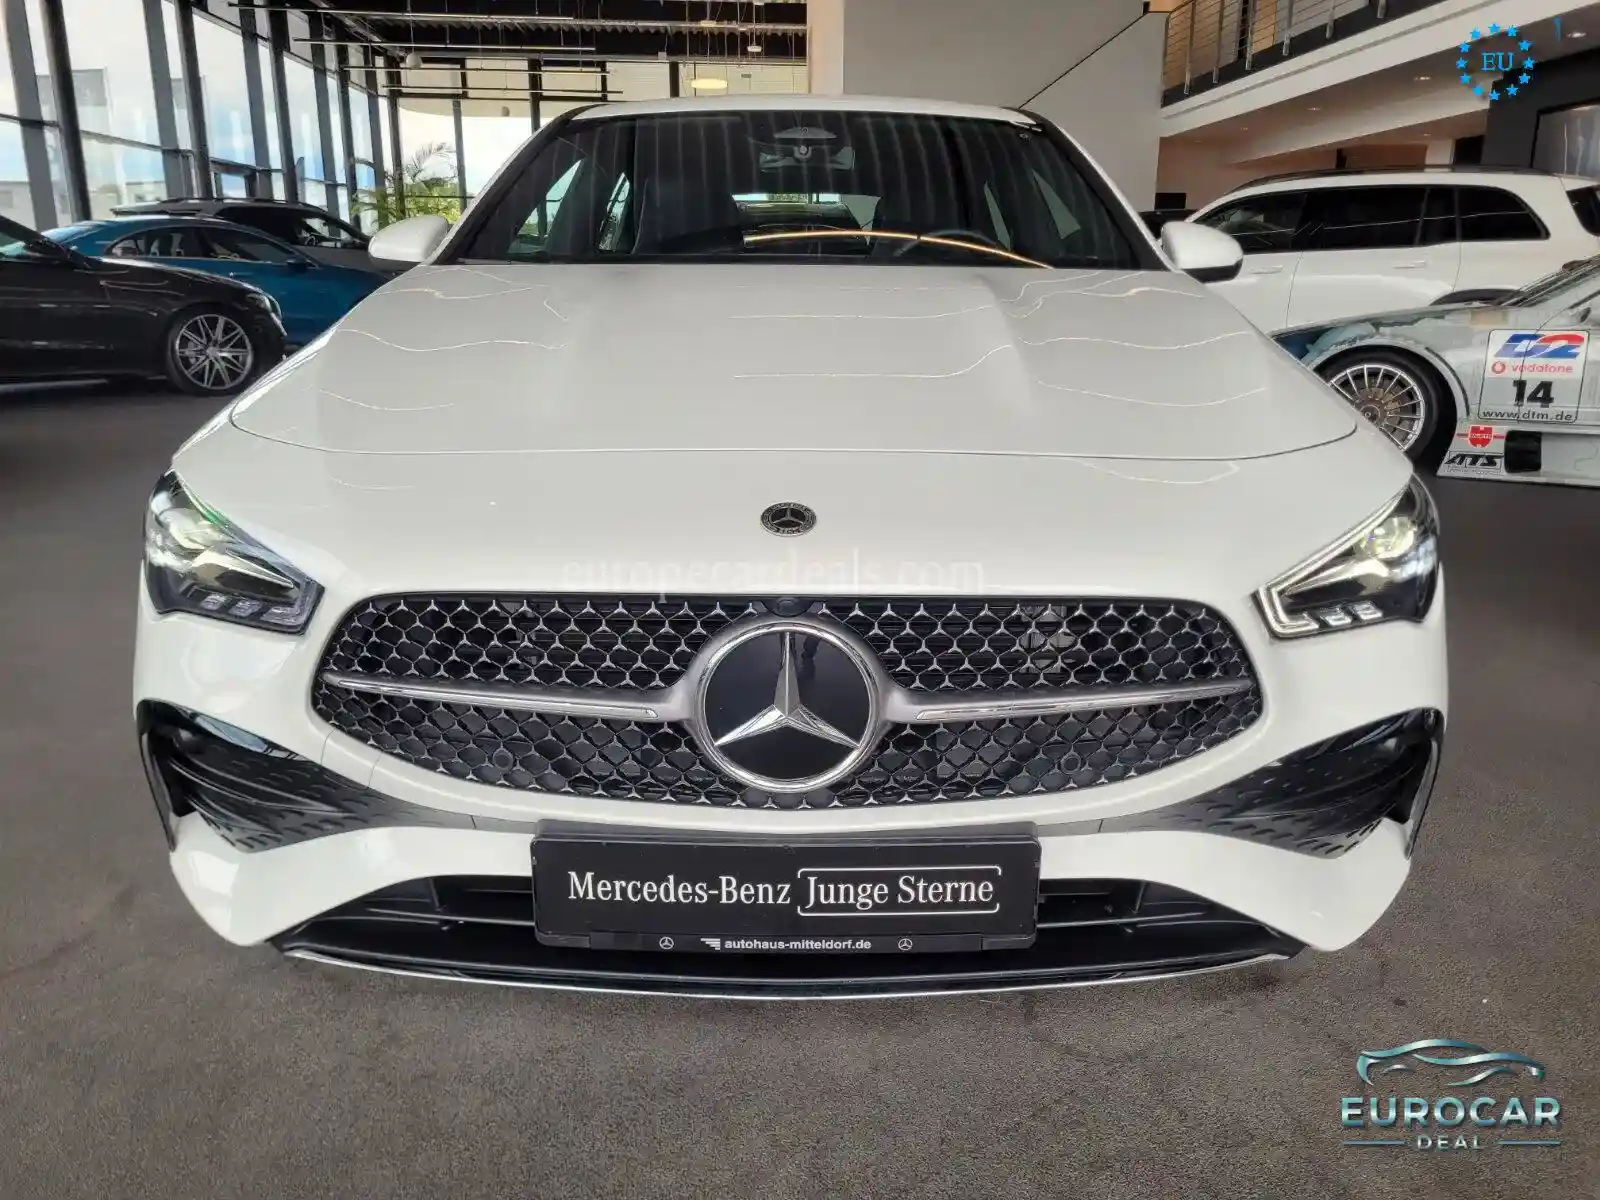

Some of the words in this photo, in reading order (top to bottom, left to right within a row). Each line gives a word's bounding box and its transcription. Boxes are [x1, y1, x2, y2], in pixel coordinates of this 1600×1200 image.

[1512, 361, 1573, 373] vodafone
[1513, 379, 1555, 408] 14
[1482, 410, 1573, 421] www.dtm.de
[1444, 453, 1498, 467] ATS
[567, 871, 792, 905] Mercedes-Benz
[805, 876, 889, 910] Junge
[897, 876, 994, 904] Sterne
[724, 938, 872, 951] autohaus-mitteldorf.de
